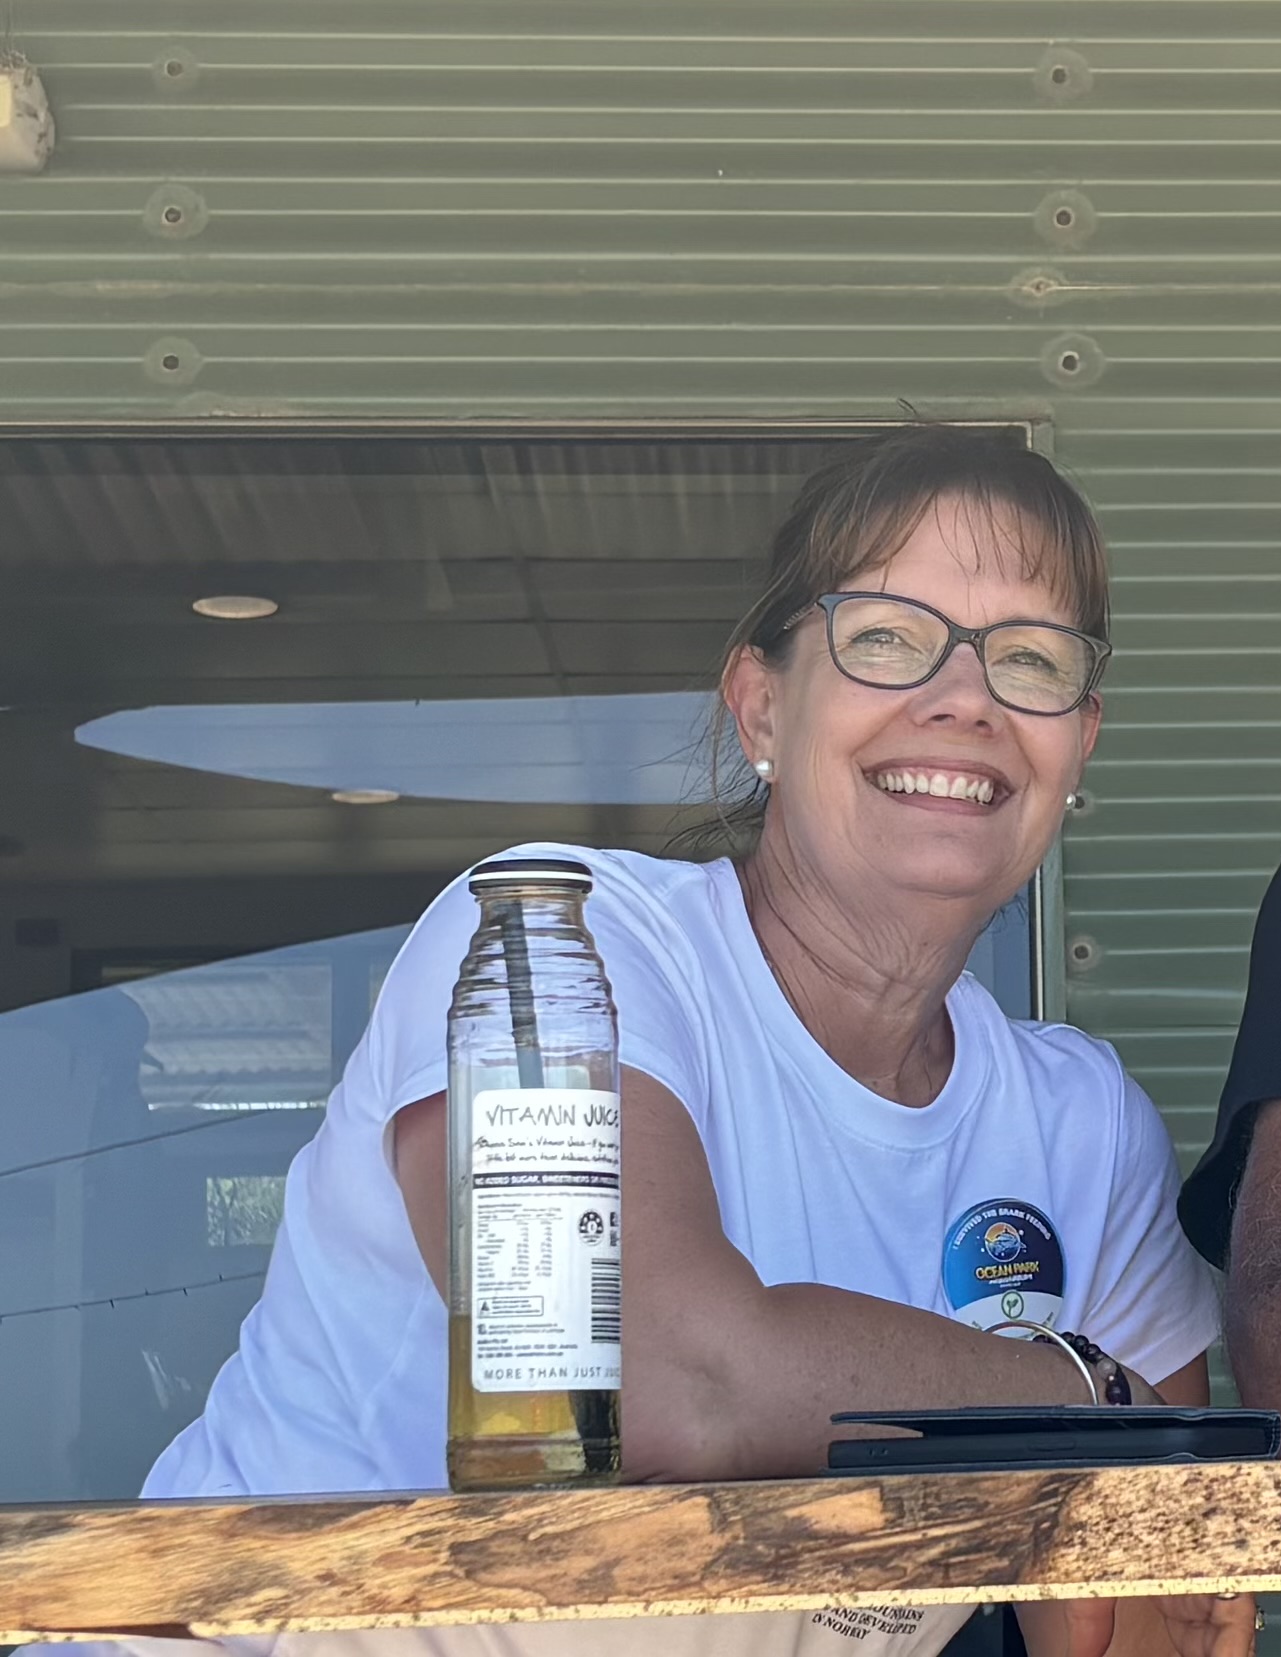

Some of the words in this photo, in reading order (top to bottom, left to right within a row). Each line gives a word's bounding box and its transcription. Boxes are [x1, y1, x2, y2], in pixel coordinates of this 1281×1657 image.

[486, 1104, 576, 1127] VITAMIN
[975, 1264, 1013, 1280] OCEAN
[1013, 1260, 1040, 1274] PARK
[484, 1368, 522, 1380] MORE
[528, 1367, 568, 1378] THAN
[573, 1366, 602, 1378] JUST
